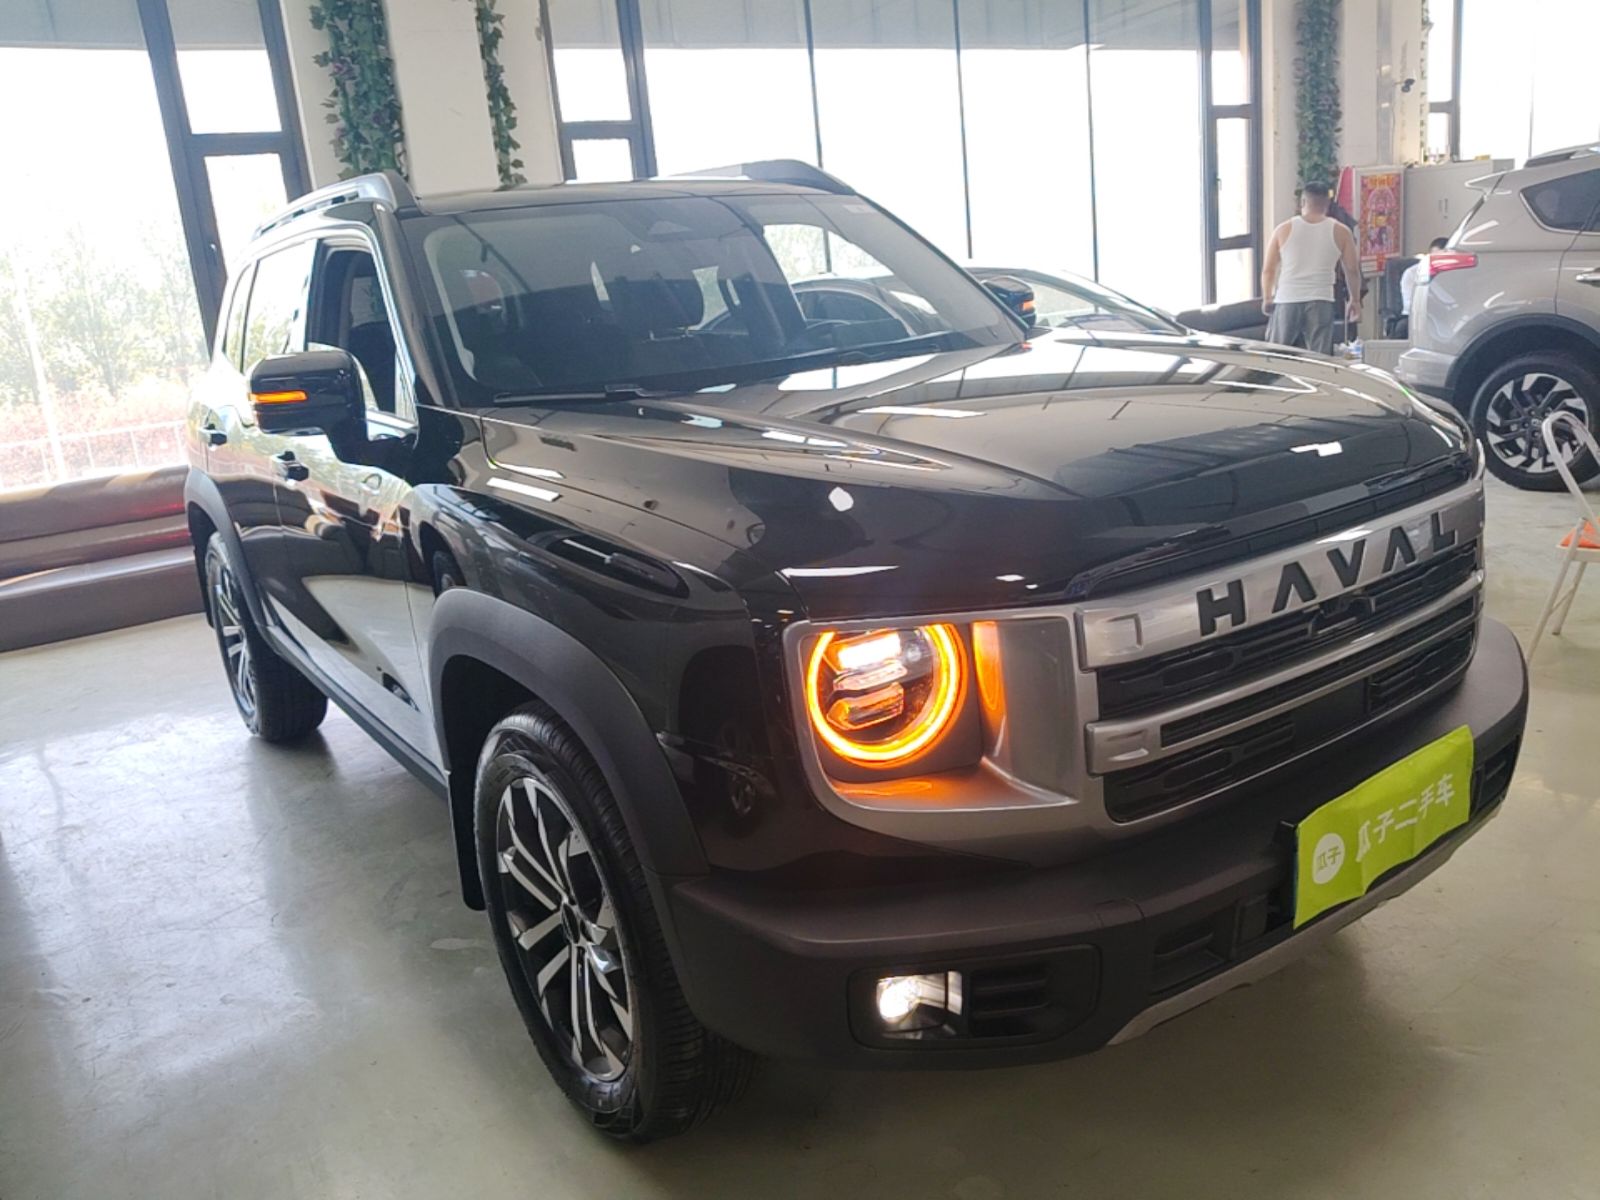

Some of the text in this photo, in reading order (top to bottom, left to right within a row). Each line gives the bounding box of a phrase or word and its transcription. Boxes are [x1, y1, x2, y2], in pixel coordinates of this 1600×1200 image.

[1196, 511, 1457, 637] HAVAL
[1356, 773, 1455, 862] 瓜子二手车
